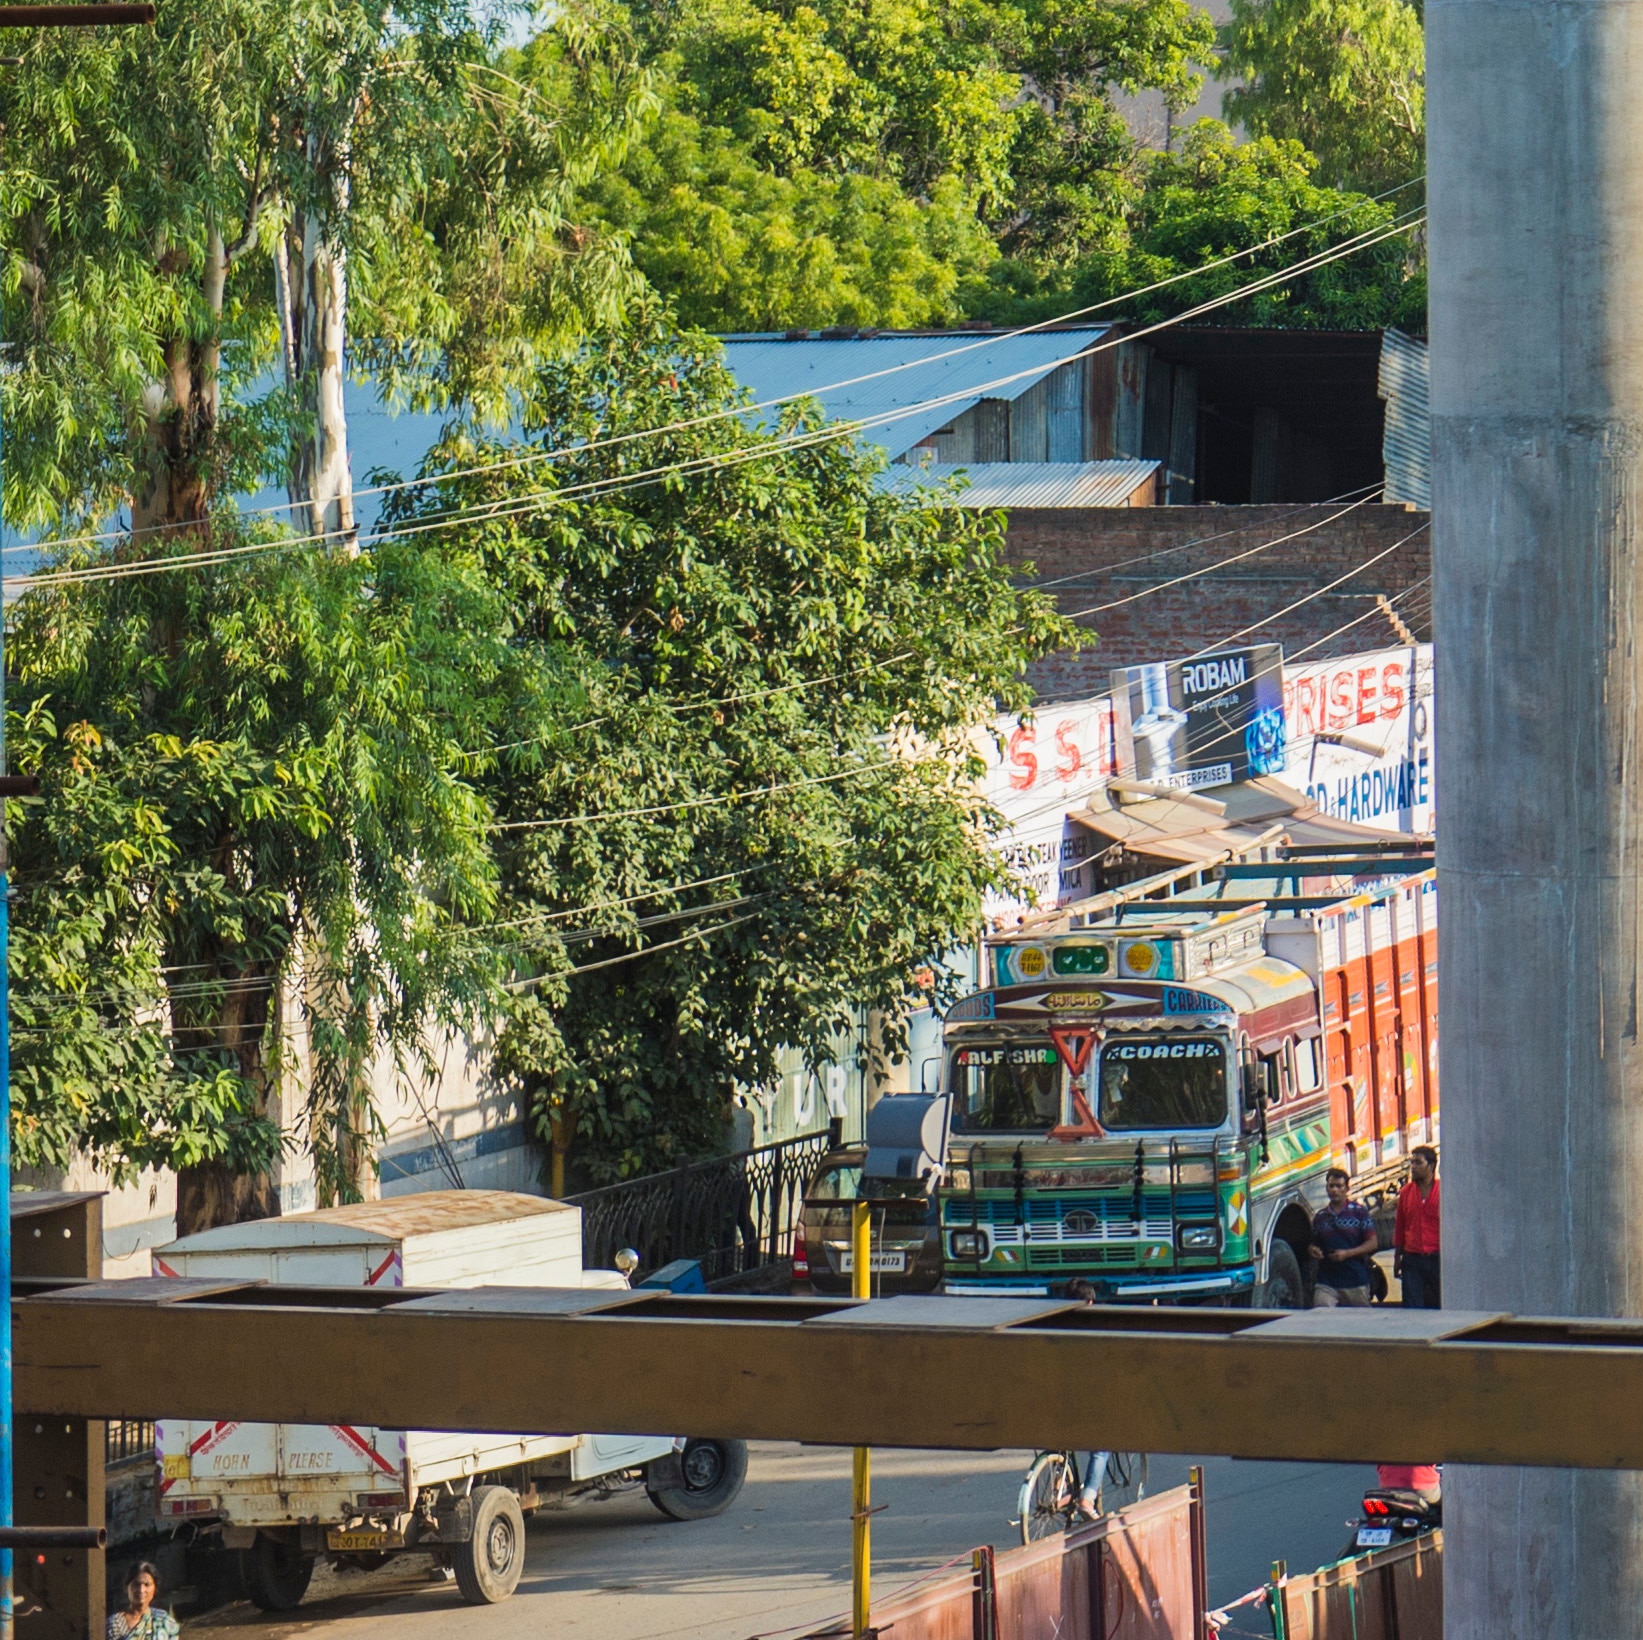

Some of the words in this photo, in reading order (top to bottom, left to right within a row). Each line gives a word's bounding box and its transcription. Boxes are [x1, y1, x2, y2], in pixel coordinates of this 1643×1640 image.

[1182, 657, 1246, 695] ROBAM
[1168, 766, 1228, 788] ENTERPRISES
[1338, 754, 1428, 824] HARDWARE
[1120, 1044, 1199, 1059] COACH
[213, 1453, 250, 1471] HORN
